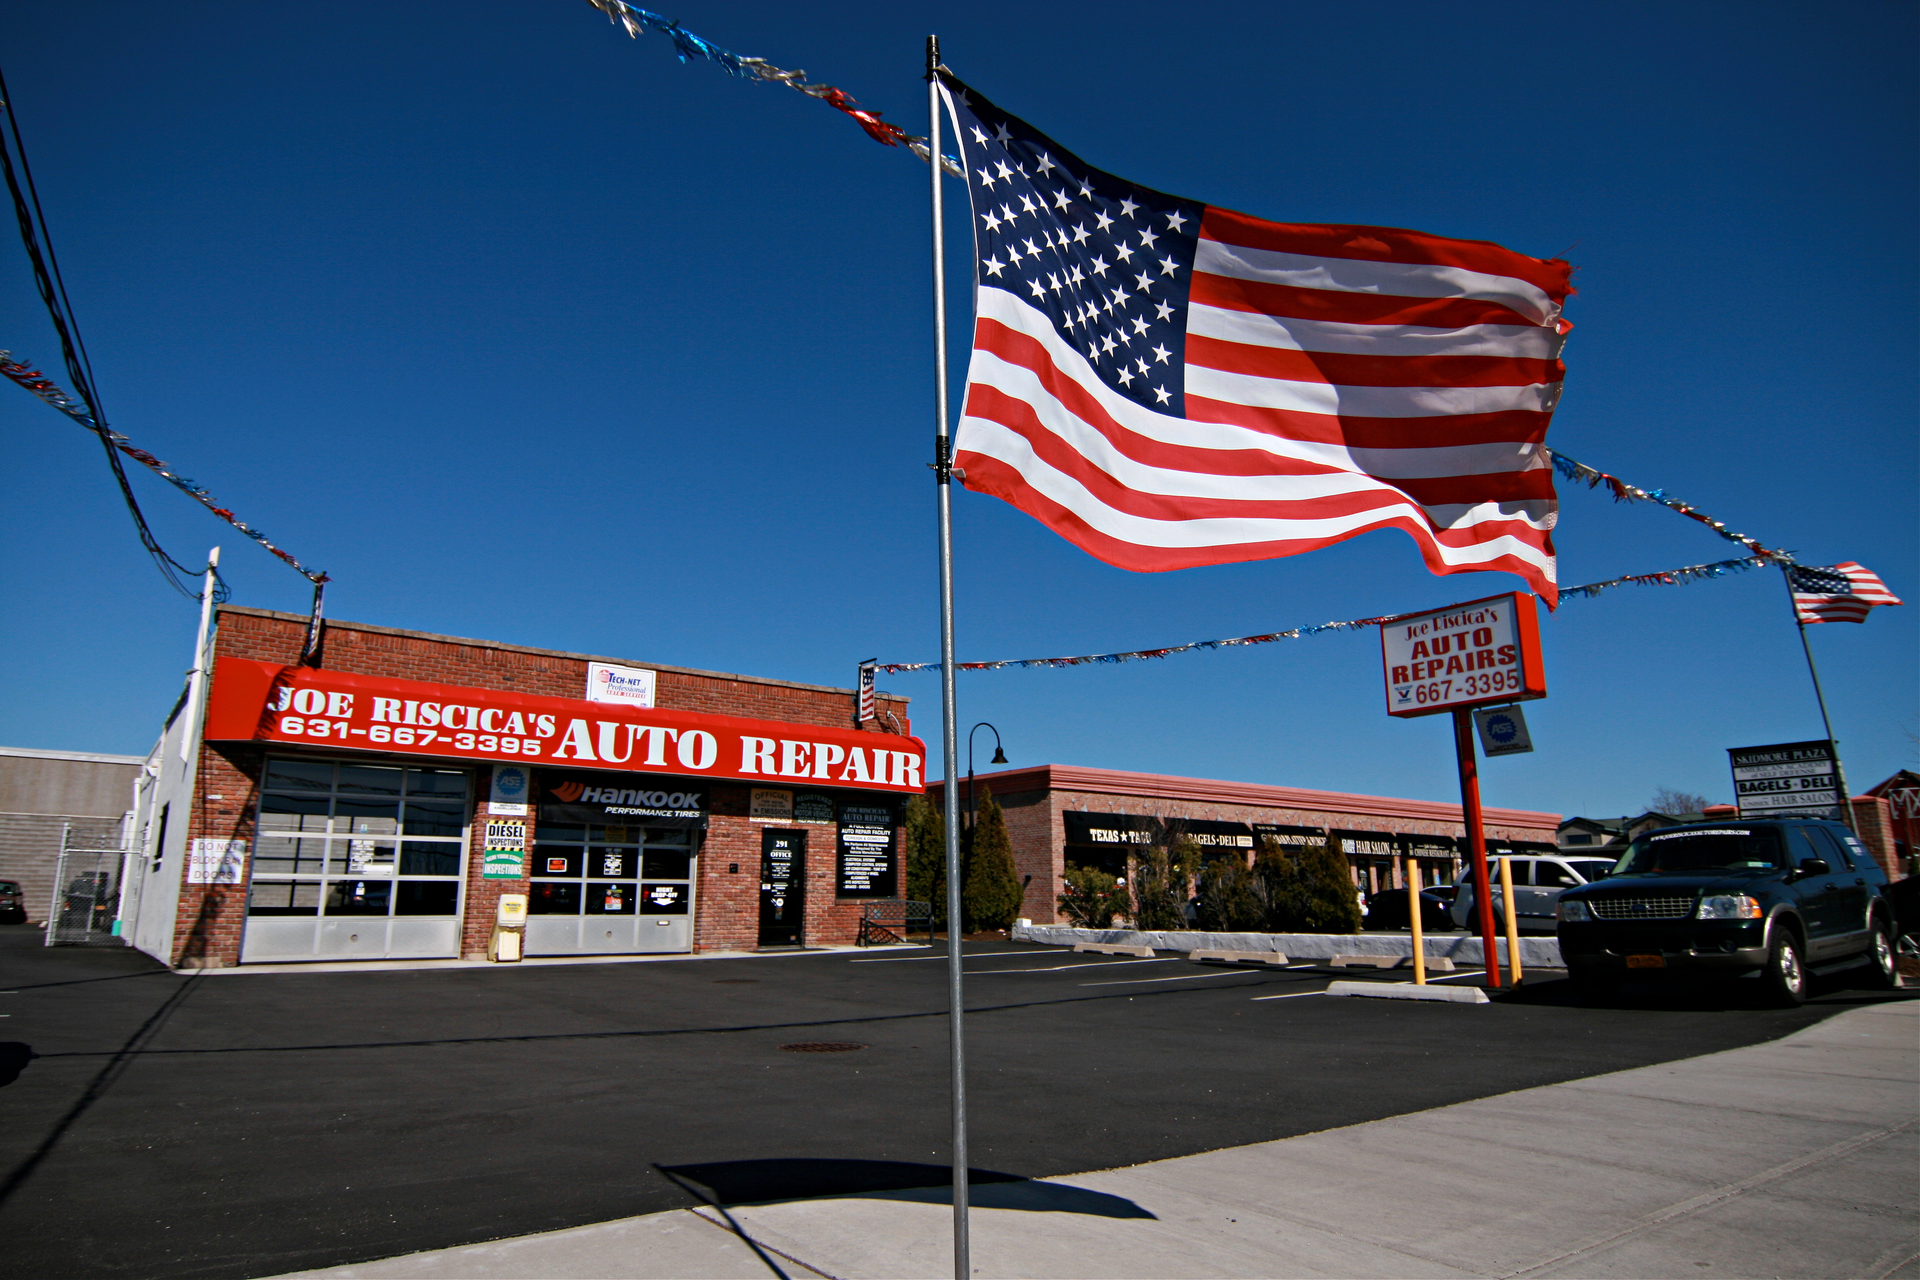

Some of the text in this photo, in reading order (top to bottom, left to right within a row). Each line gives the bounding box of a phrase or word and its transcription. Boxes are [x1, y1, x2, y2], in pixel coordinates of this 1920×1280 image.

[1405, 608, 1498, 641] Joe Riscica's
[1411, 627, 1493, 660] AUTO
[1392, 644, 1516, 685] REPAIRS
[607, 683, 647, 694] Professional
[1416, 668, 1519, 704] 667-3395
[267, 686, 556, 738] JOE RISCICA'S
[1491, 722, 1514, 735] ASE
[280, 716, 542, 756] 631-667-3395
[551, 718, 923, 788] AUTO REPAIR
[1735, 748, 1828, 765] SKIDMORE PLAZA
[1739, 761, 1827, 774] AMERICAN ACADEMY
[500, 776, 521, 786] ASE
[1739, 777, 1833, 793] BAGELS DELI
[755, 791, 789, 802] OFFICIAL
[795, 793, 833, 806] REGISTERED
[1771, 796, 1798, 806] HAIR
[1799, 792, 1836, 804] SALON
[605, 806, 701, 818] PERFORMANCE TIRES
[794, 809, 834, 818] MOTOR VEHICLE
[864, 814, 890, 823] REPAIR
[489, 825, 523, 838] DIESEL
[1089, 828, 1119, 843] TEXAS
[198, 842, 238, 851] DO NOT
[488, 838, 523, 847] INSPECTIONS
[776, 840, 788, 848] 291
[1219, 834, 1236, 847] DELI
[1355, 840, 1371, 854] HAIR
[1371, 841, 1390, 855] SALON
[192, 855, 223, 865] BLOCK
[484, 864, 522, 875] INSPECTIONS
